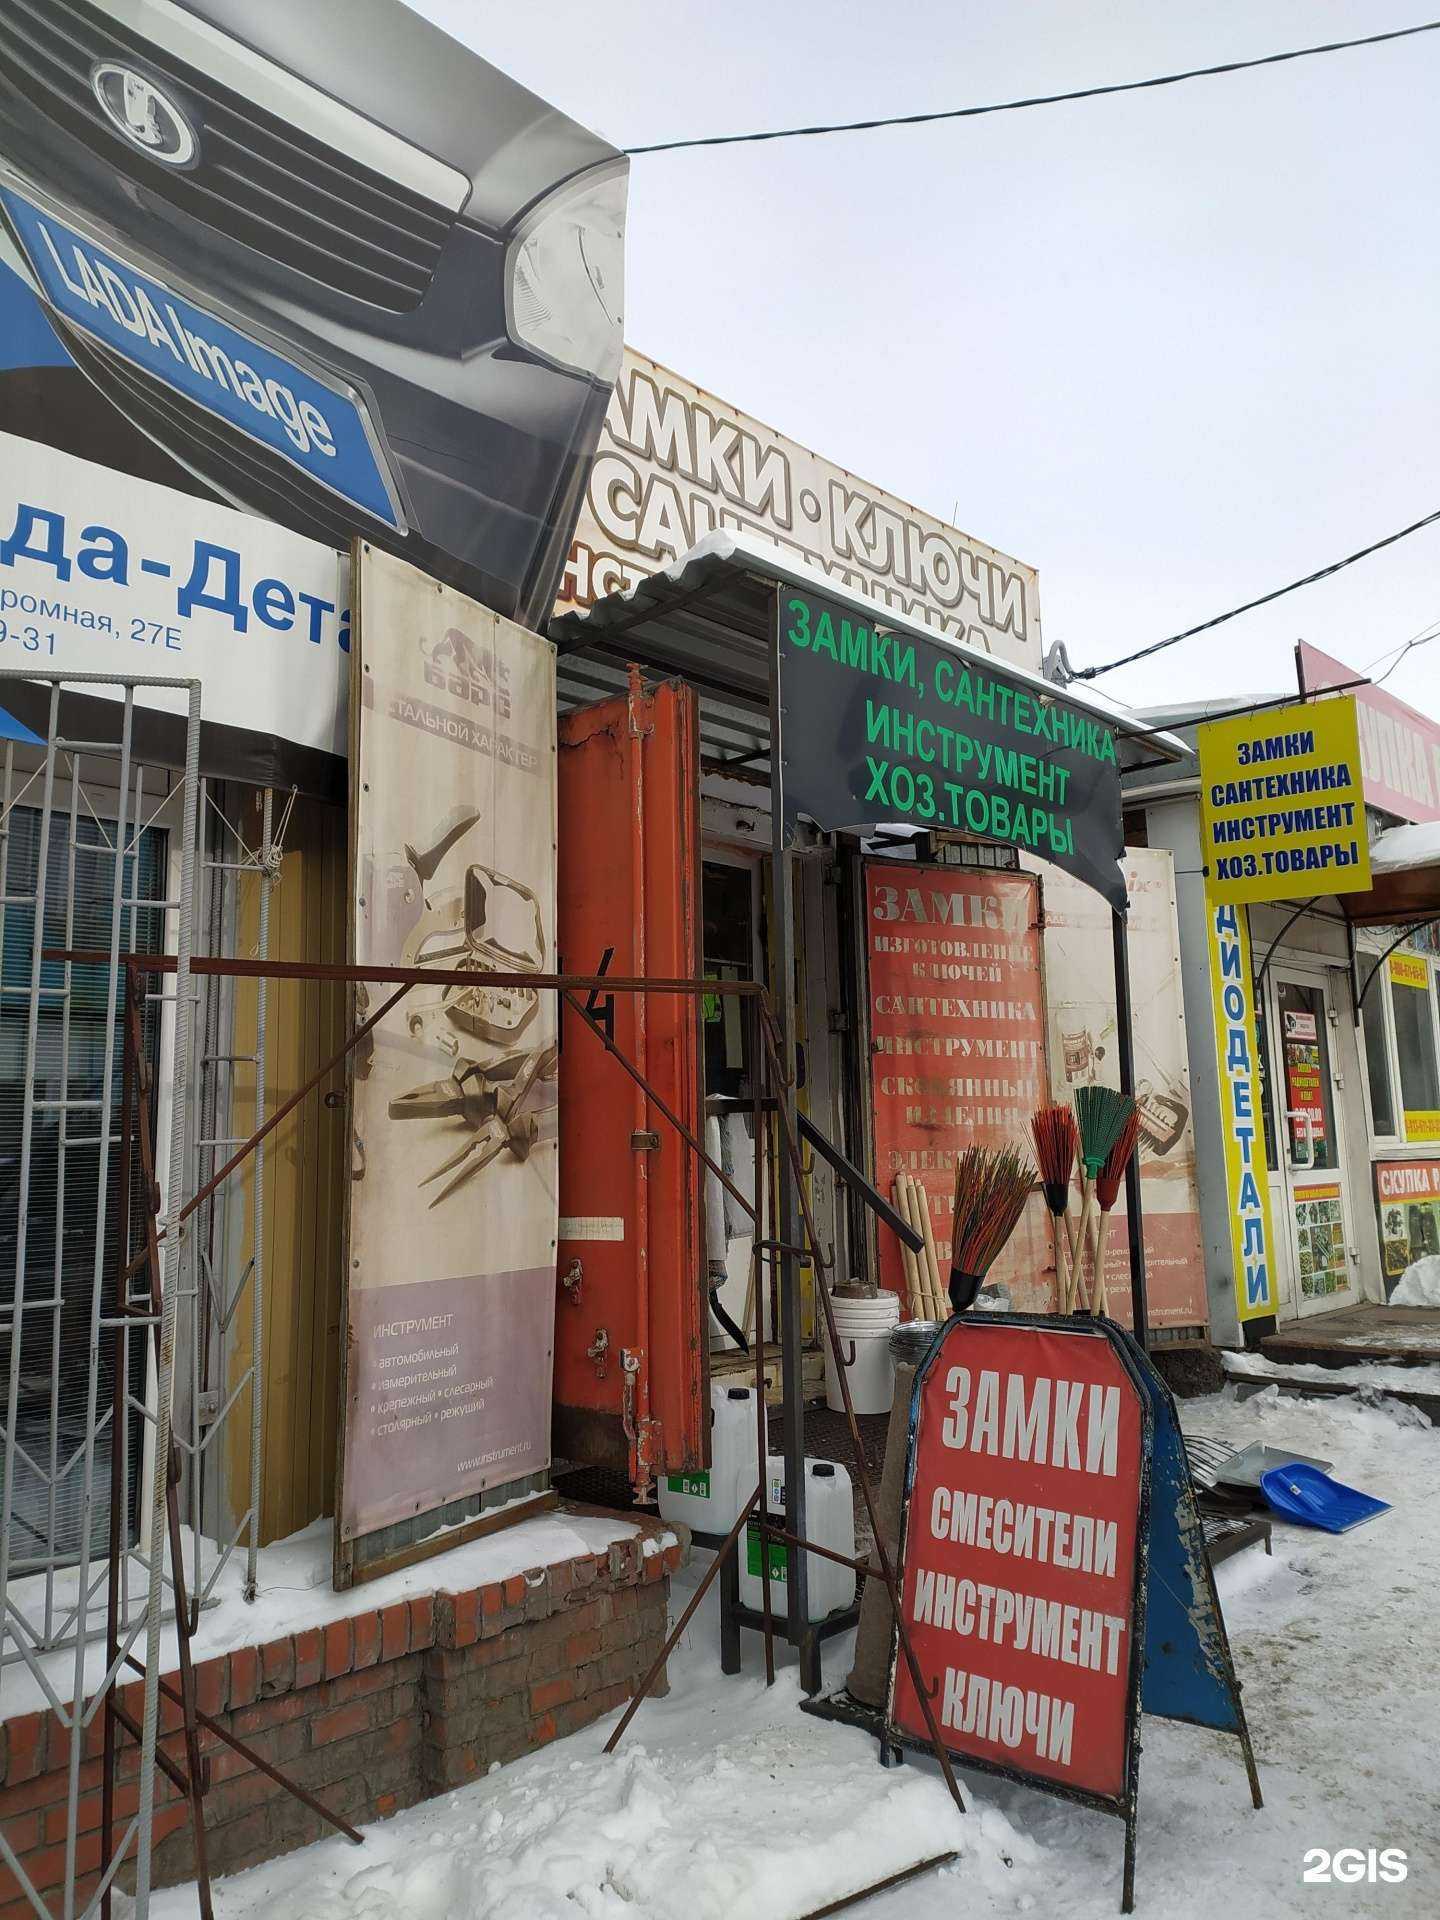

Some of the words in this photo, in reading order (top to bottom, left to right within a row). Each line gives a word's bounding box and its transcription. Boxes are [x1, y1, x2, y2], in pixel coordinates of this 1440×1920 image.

[38, 221, 184, 363] LADA
[166, 304, 337, 457] Image
[0, 503, 350, 654] да-Дет
[829, 479, 1027, 641] КЛЮЧИ
[788, 598, 925, 699] ЗАМКИ,
[934, 659, 1118, 767] САНТЕХНИКА
[388, 701, 469, 742] ТАЛЬНОЙ
[865, 698, 1072, 806] ИНСТРУМЕНТ
[1237, 730, 1315, 766] ЗАМКИ
[864, 755, 1075, 856] ХОЗ.ТОВАРЫ
[1210, 763, 1353, 808] САНТЕХНИКА
[1212, 801, 1356, 845] ИНСТРУМЕНТ
[1215, 841, 1359, 881] ХОЗ.ТОВАРЫ
[873, 886, 1032, 933] ЗАМКИ
[875, 994, 1038, 1020] САНТЕХНИКА
[874, 1034, 1041, 1059] ИНСТРУМЕНТ
[1381, 1168, 1431, 1196] СКУПКА
[373, 1313, 454, 1339] ИНСТРУМЕНТ
[378, 1364, 457, 1391] змерительный
[379, 1344, 460, 1369] автомобильный
[942, 1366, 1121, 1478] ЗАМКИ
[930, 1486, 1119, 1579] СМЕСИТЕЛИ
[913, 1568, 1126, 1677] ИНСТРУМЕНТ
[941, 1667, 1076, 1767] КЛЮЧИ
